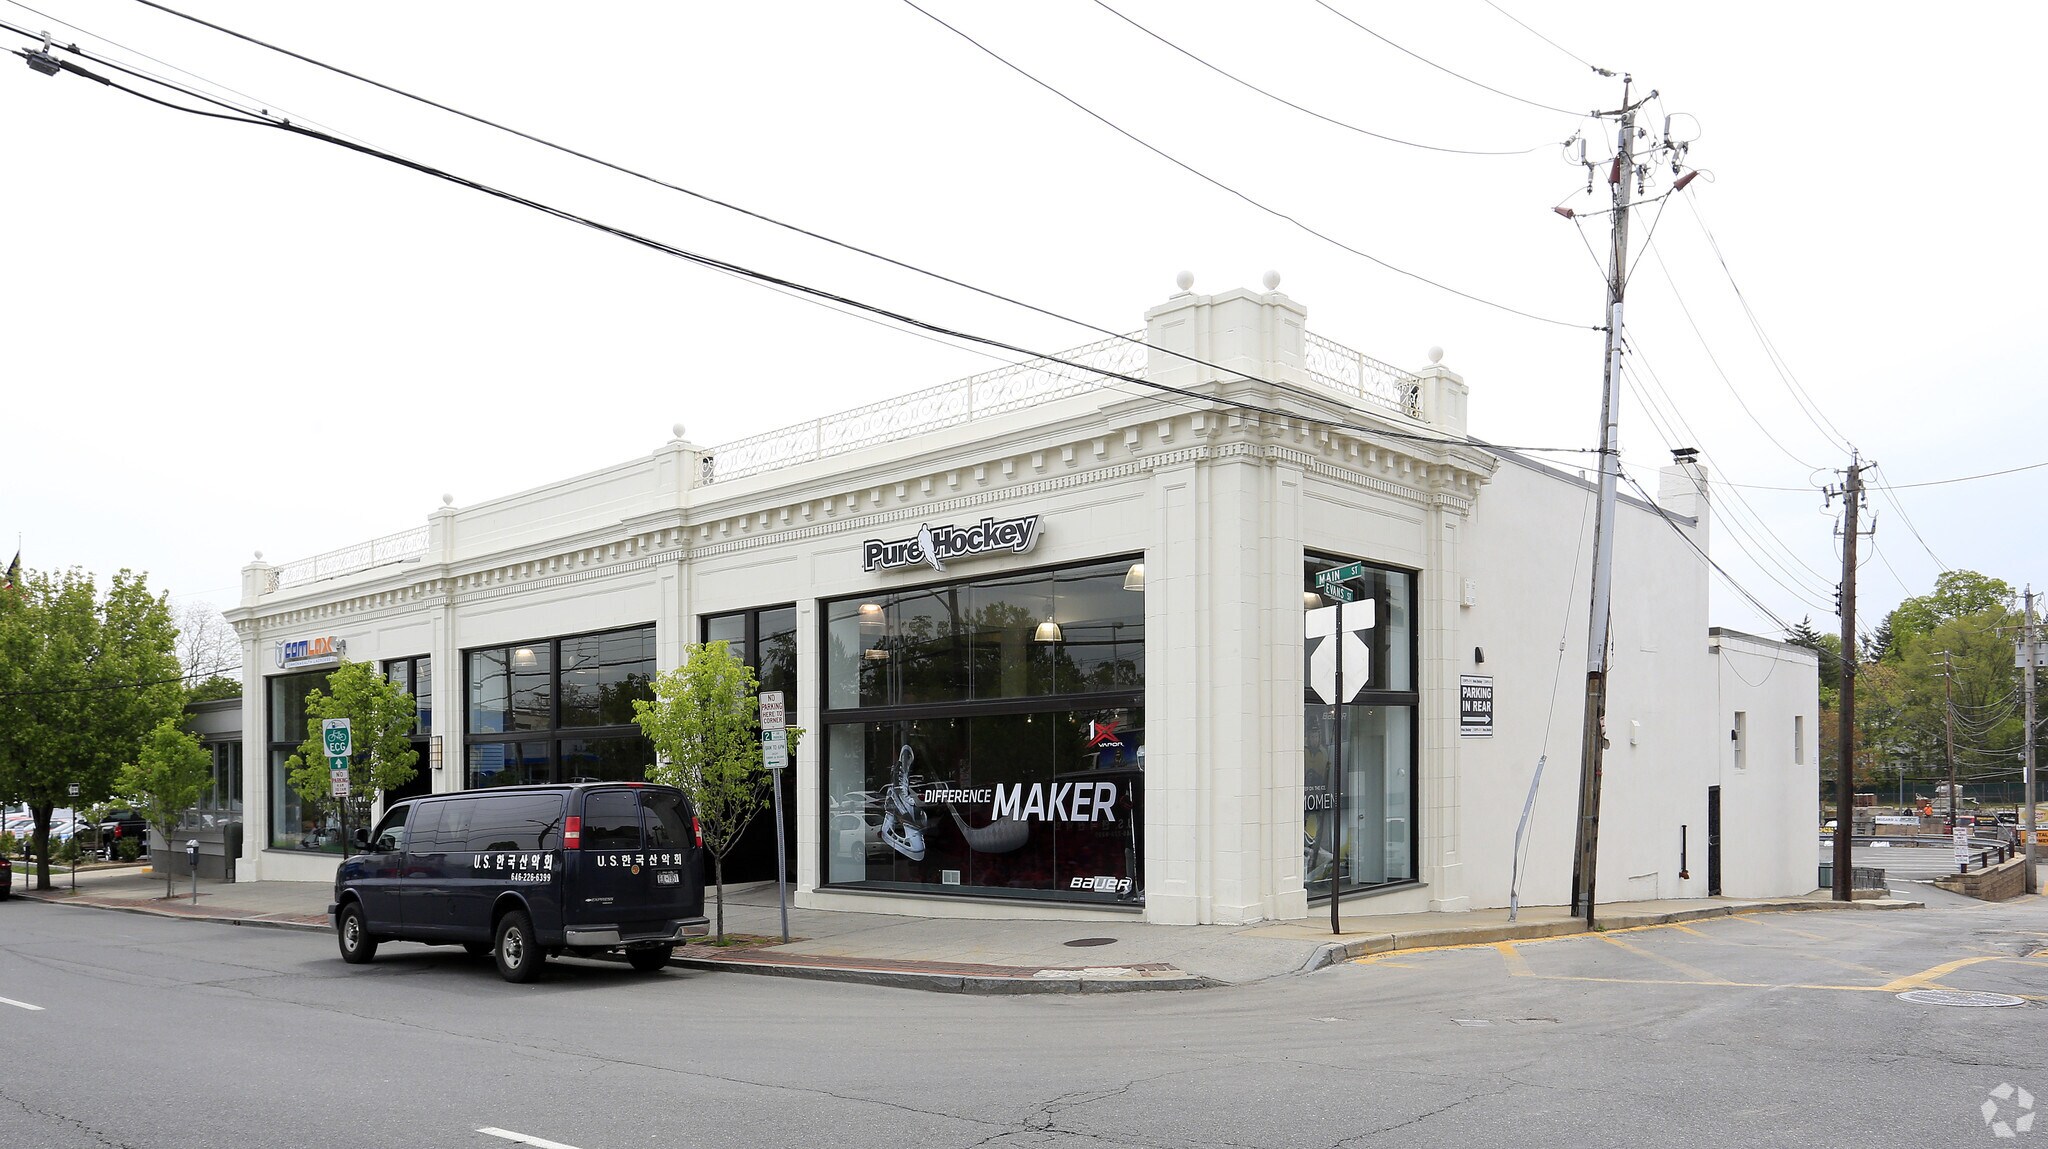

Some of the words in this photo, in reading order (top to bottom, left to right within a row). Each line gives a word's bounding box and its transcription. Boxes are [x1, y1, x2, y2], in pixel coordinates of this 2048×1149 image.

[864, 539, 922, 571] Pure
[932, 515, 1039, 557] Hockey
[1319, 570, 1340, 585] MAIN
[1351, 566, 1358, 575] ST
[1325, 582, 1345, 599] EVANS
[1346, 592, 1352, 600] ST
[1463, 687, 1491, 699] PARKING
[1463, 701, 1470, 711] IN
[1473, 701, 1491, 711] REAR
[1322, 712, 1347, 720] BAUR
[765, 732, 770, 740] 2
[330, 743, 346, 752] ECG
[924, 789, 992, 803] DIFFERENCE
[991, 782, 1117, 822] MAKER
[473, 854, 491, 869] U.S.
[496, 854, 553, 870] 한국산악회
[597, 855, 619, 867] U.S.
[621, 853, 682, 866] 한국산악회
[510, 872, 551, 882] 646-226-6399
[1070, 877, 1130, 890] BAUER
